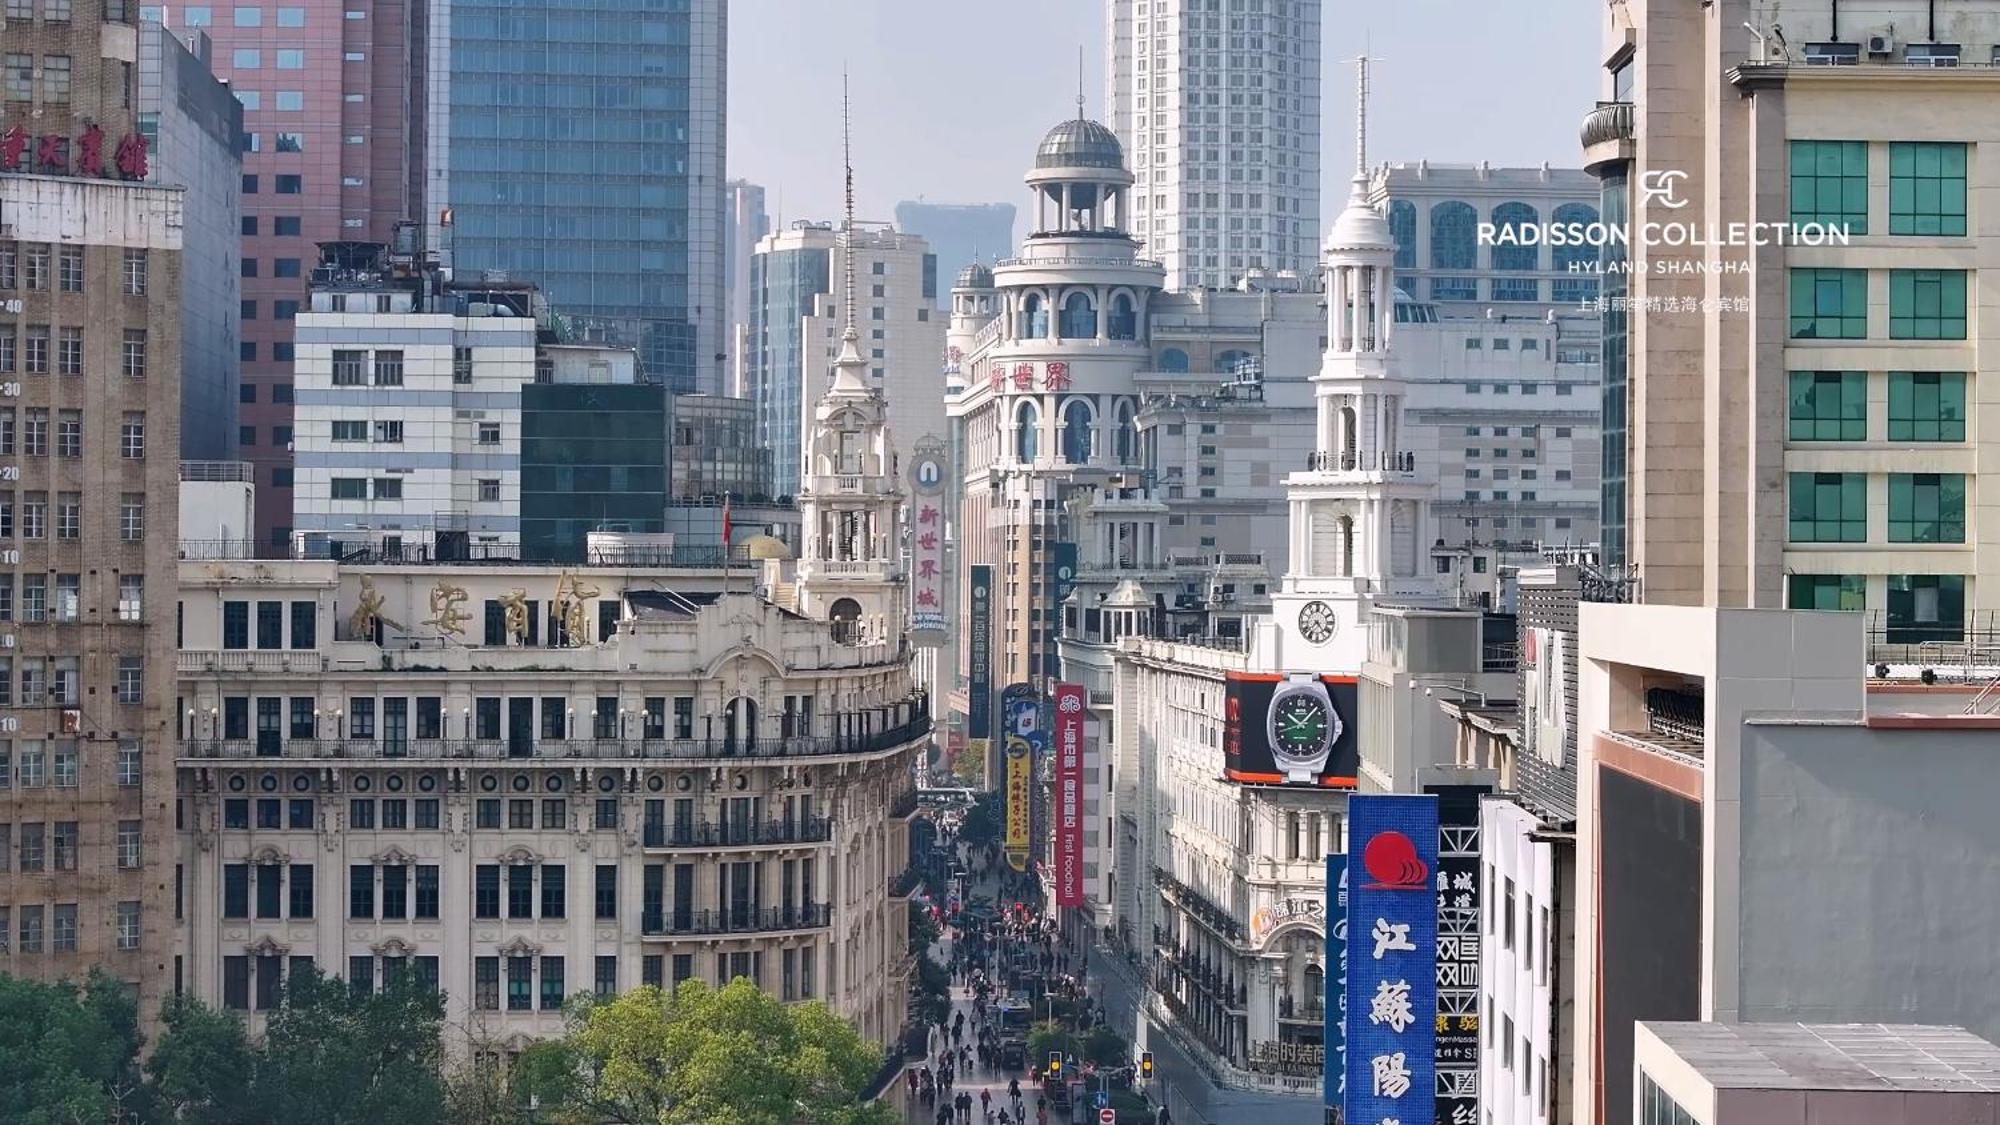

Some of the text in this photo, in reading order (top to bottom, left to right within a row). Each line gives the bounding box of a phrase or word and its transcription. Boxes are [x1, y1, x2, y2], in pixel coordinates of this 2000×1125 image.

[6, 299, 23, 314] 40
[3, 382, 21, 397] 30
[3, 467, 20, 481] 20
[3, 550, 19, 565] 10
[917, 504, 940, 608] 新世界城
[1, 717, 17, 732] 10
[1063, 719, 1077, 829] 上海市第一食品商店
[1064, 834, 1075, 899] First Foodhall
[1369, 916, 1418, 1125] 江蘇陽
